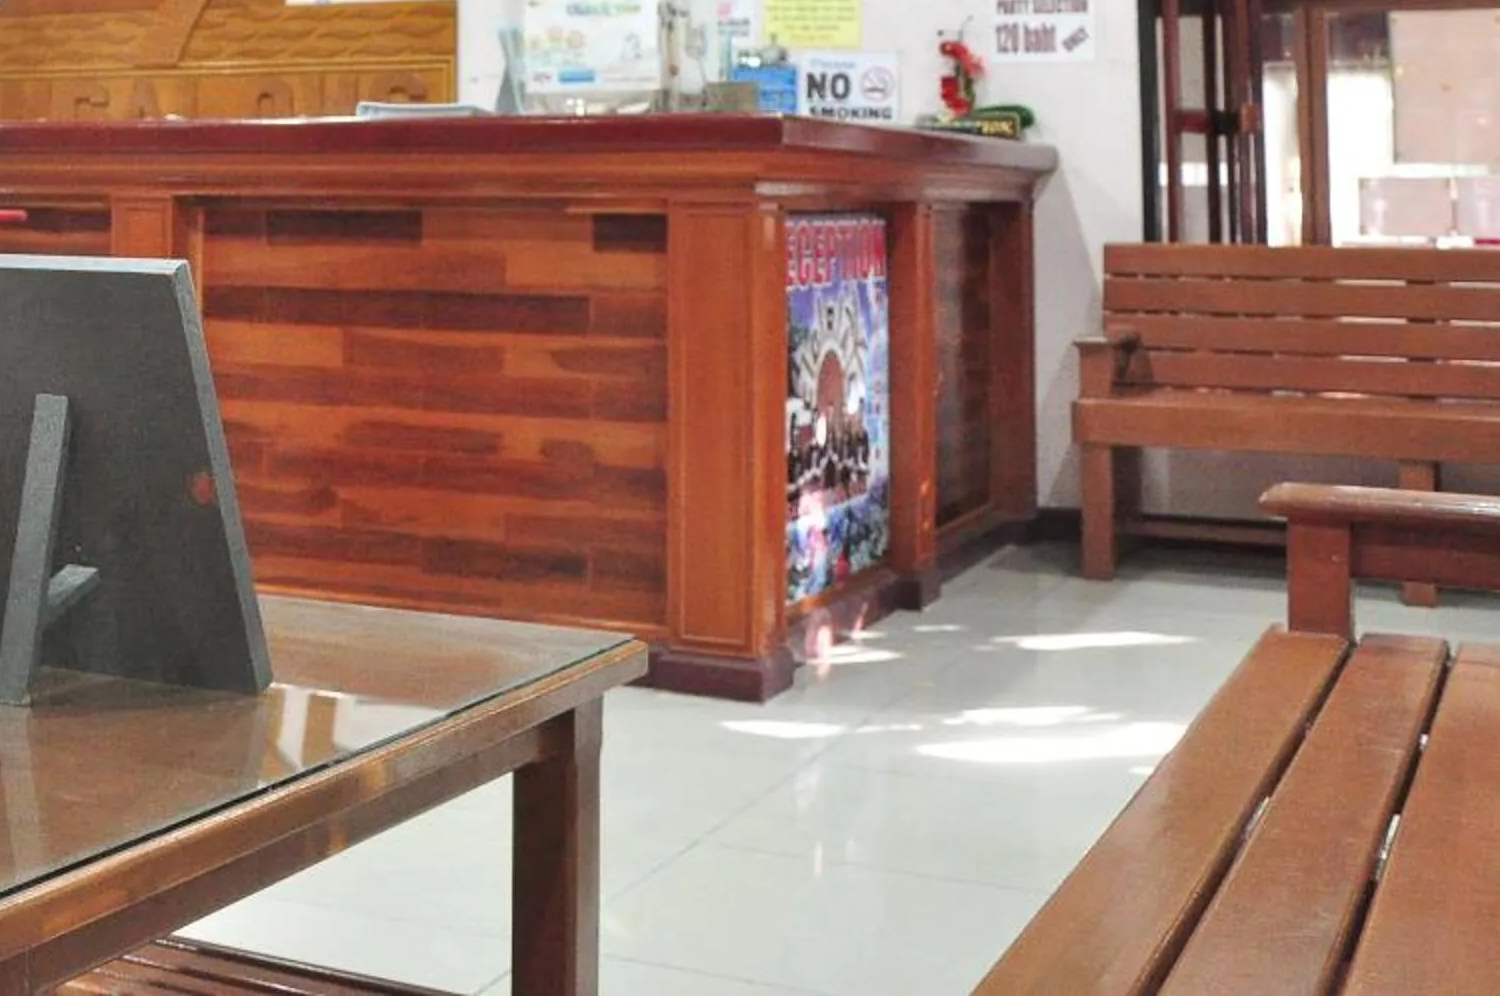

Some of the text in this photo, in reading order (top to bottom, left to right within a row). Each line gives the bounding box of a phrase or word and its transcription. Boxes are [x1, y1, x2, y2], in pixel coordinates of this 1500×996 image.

[806, 71, 851, 100] NO
[809, 105, 893, 120] SMOKING
[784, 219, 887, 291] ECEPTION
